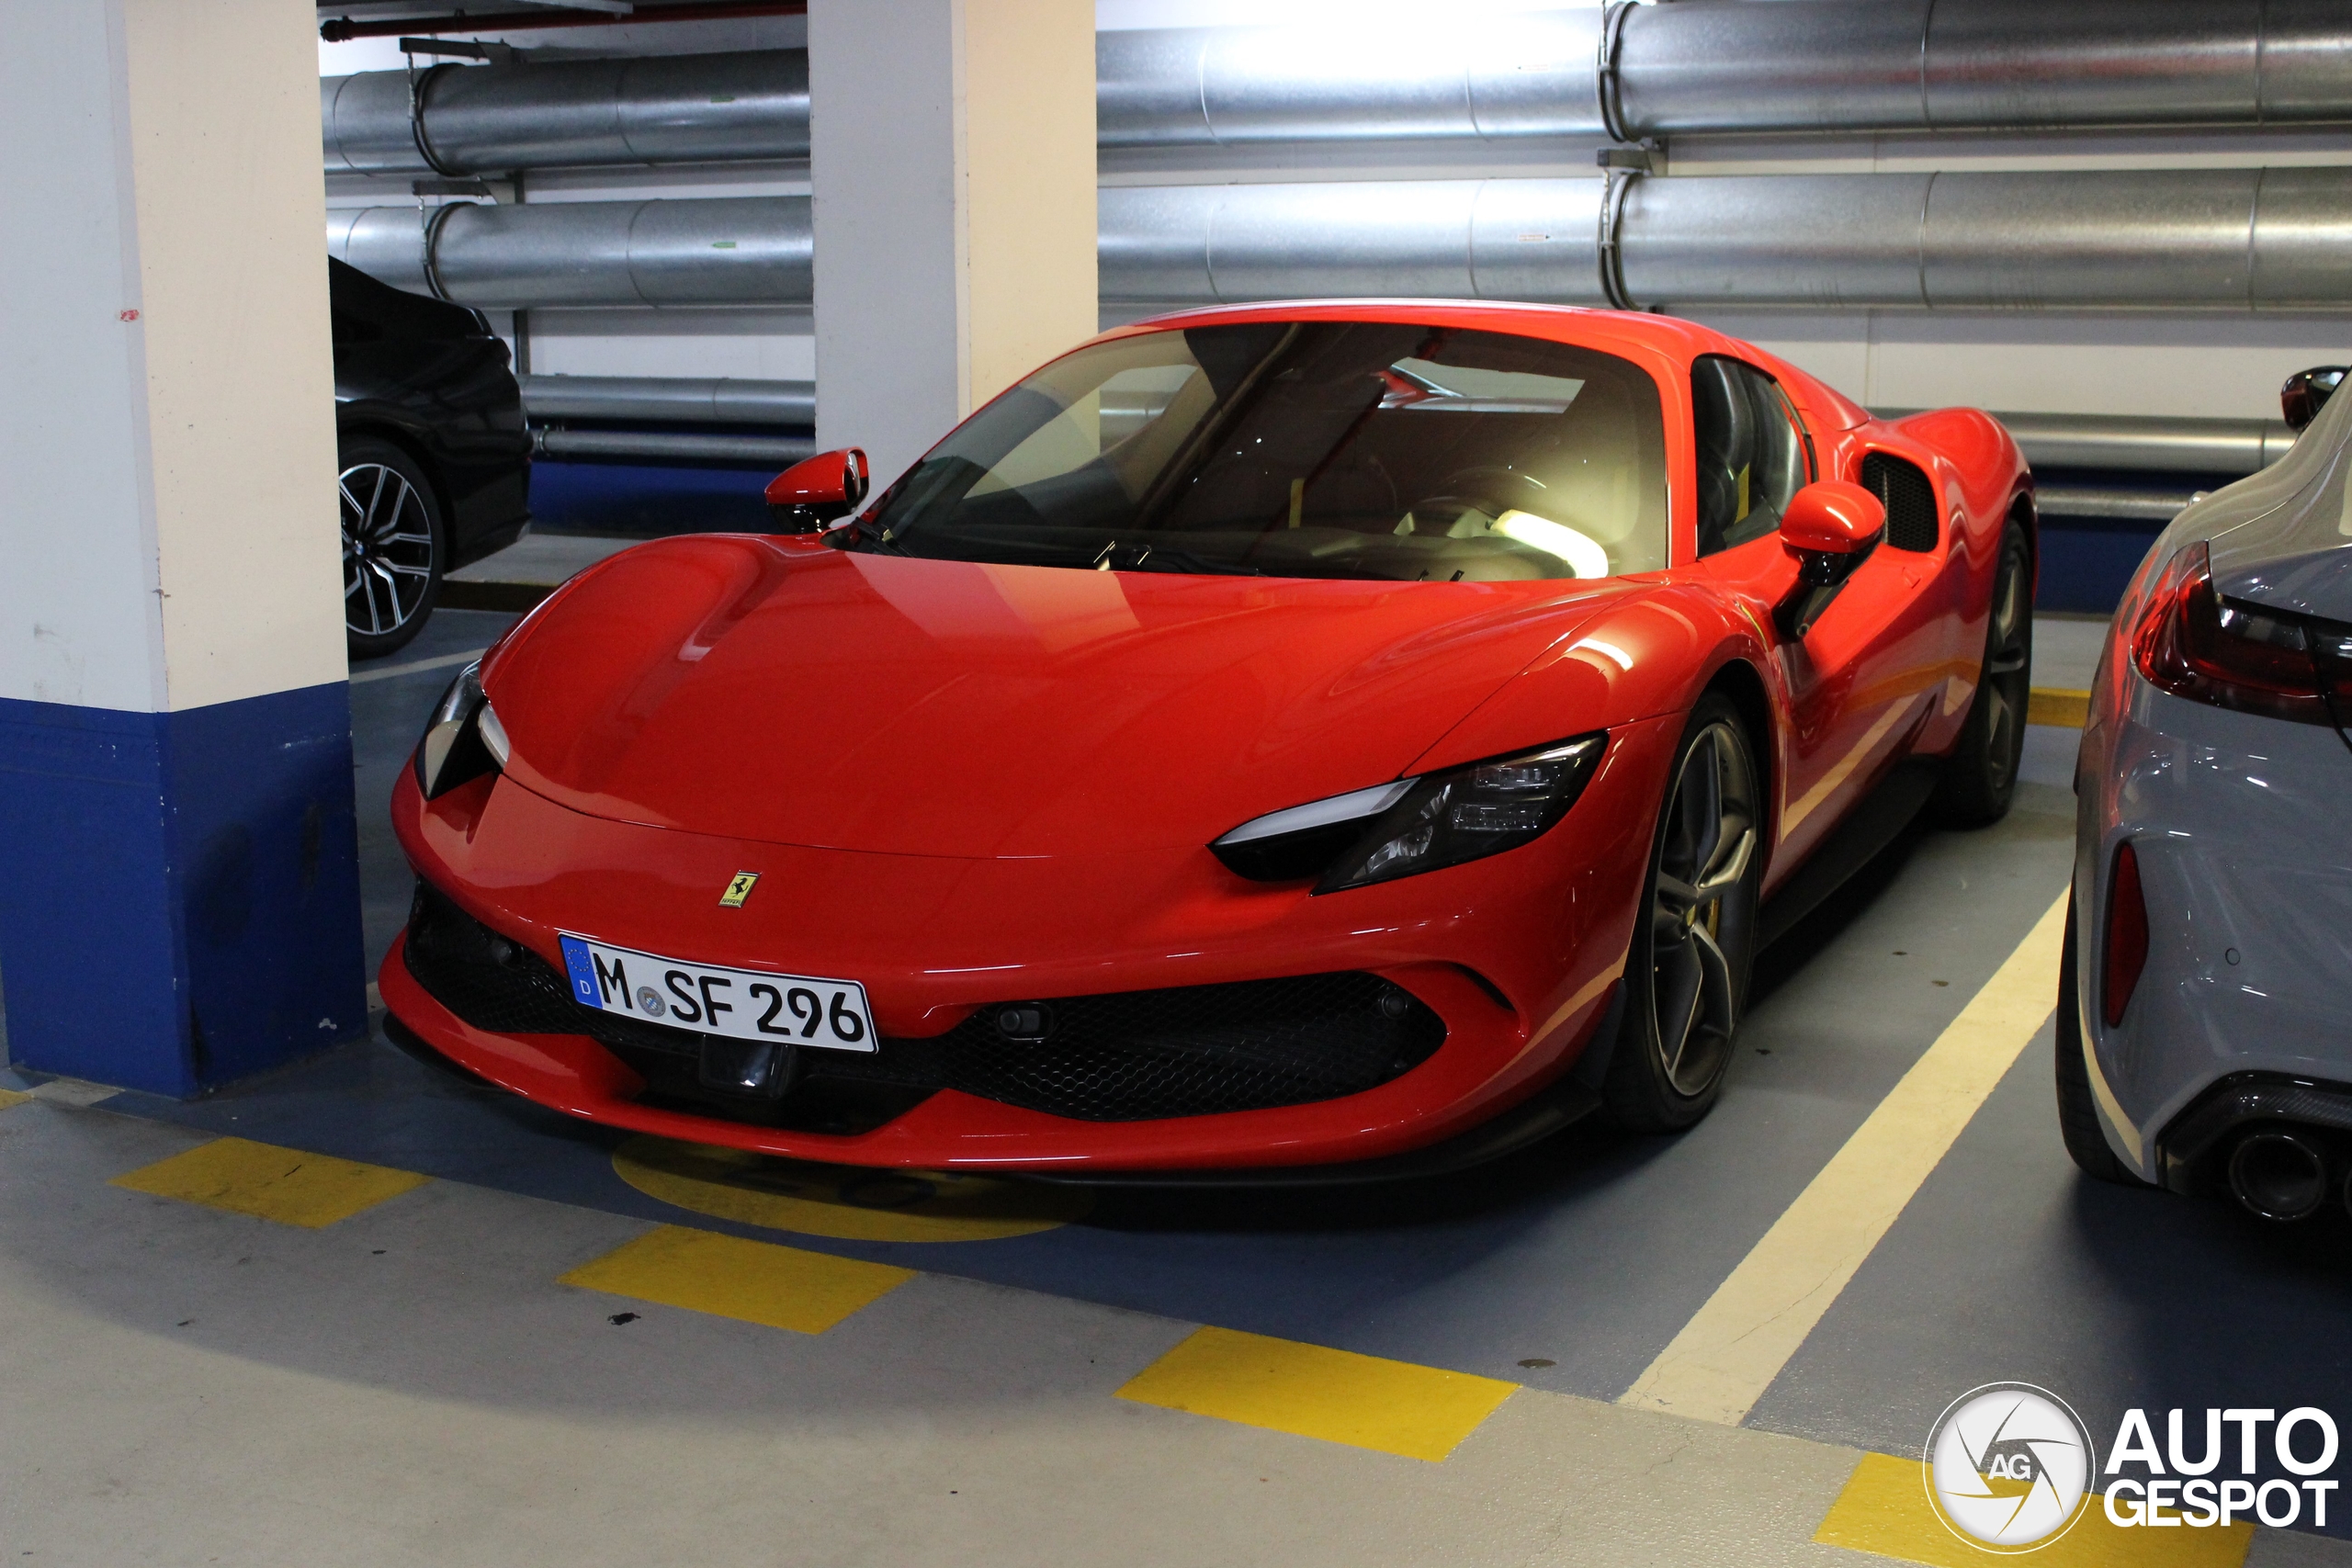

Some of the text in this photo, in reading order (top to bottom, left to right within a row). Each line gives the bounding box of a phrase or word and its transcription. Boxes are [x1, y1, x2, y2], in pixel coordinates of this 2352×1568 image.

[580, 979, 591, 995] D
[593, 953, 633, 1010] M
[664, 970, 733, 1026] SF
[750, 983, 865, 1042] 296
